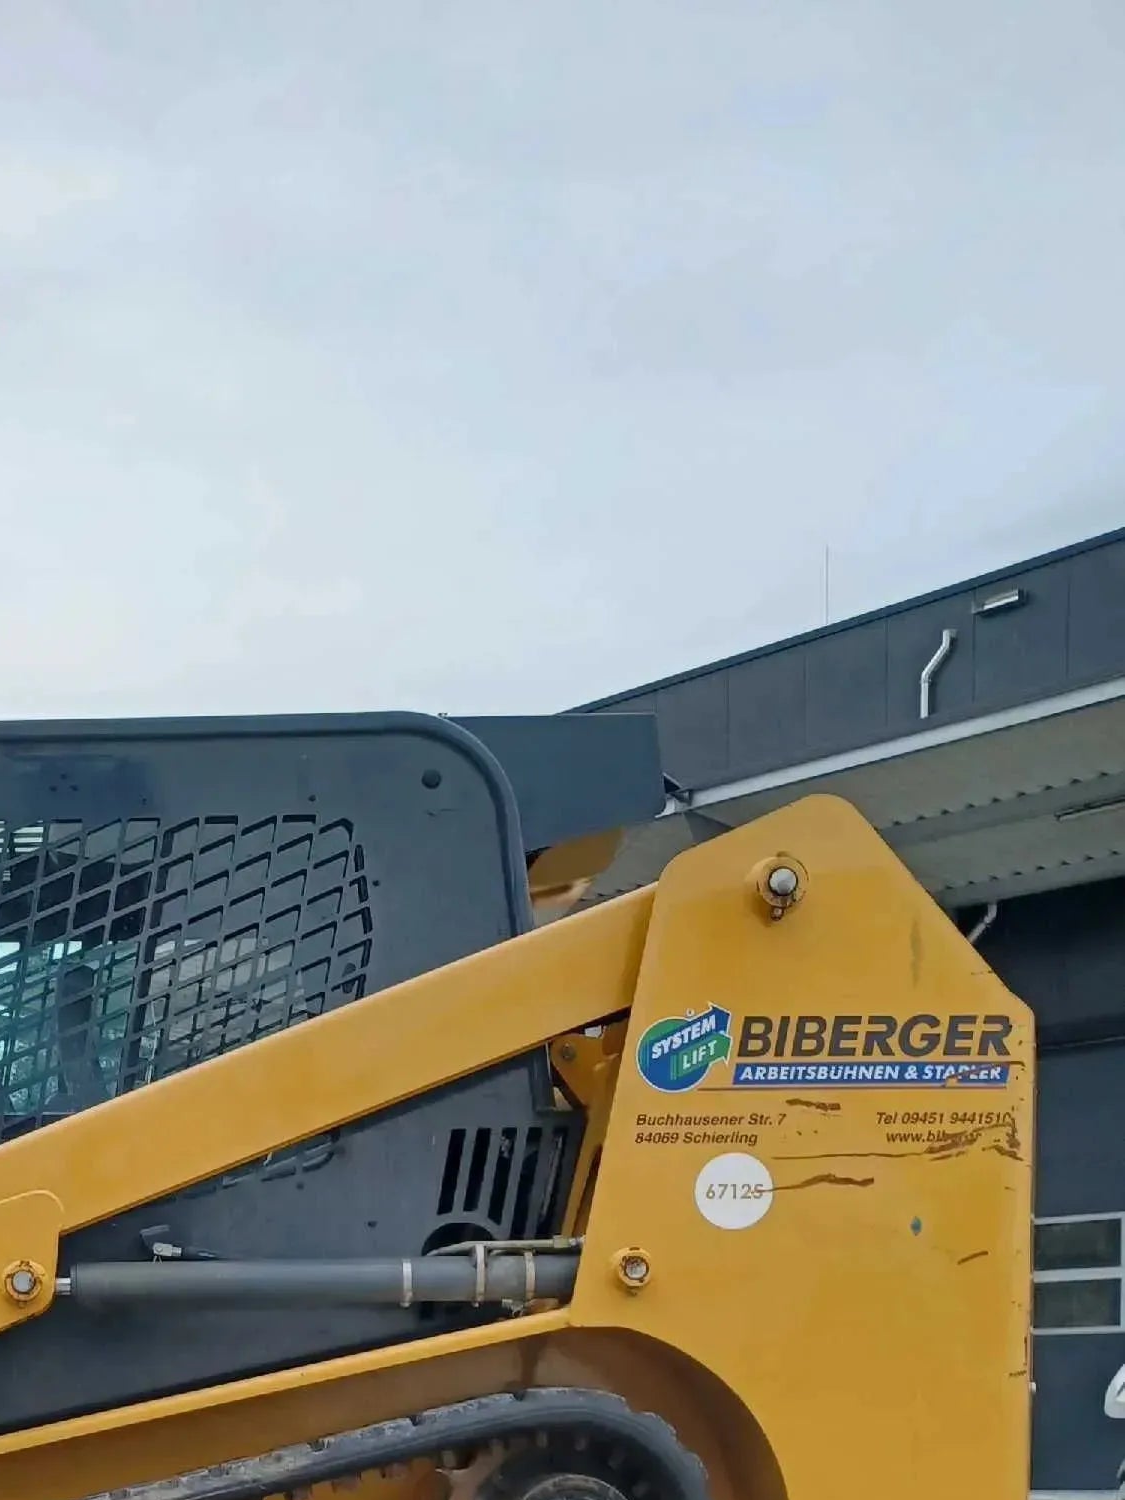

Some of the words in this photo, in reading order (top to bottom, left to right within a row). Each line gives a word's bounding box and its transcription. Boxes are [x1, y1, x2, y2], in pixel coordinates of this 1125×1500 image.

[651, 1014, 716, 1059] SYSTEM
[737, 1014, 1013, 1058] BIBERGER
[682, 1040, 717, 1070] LIFT
[740, 1064, 900, 1081] ARBEITSBÜHNEN
[904, 1064, 918, 1080] &
[636, 1112, 745, 1127] Buchhausener
[747, 1112, 773, 1126] Str.
[777, 1113, 787, 1126] 7
[876, 1111, 898, 1125] Tel
[901, 1111, 945, 1125] 09451
[635, 1131, 679, 1145] 84069
[683, 1131, 758, 1147] Schierling
[705, 1183, 764, 1200] 67125
